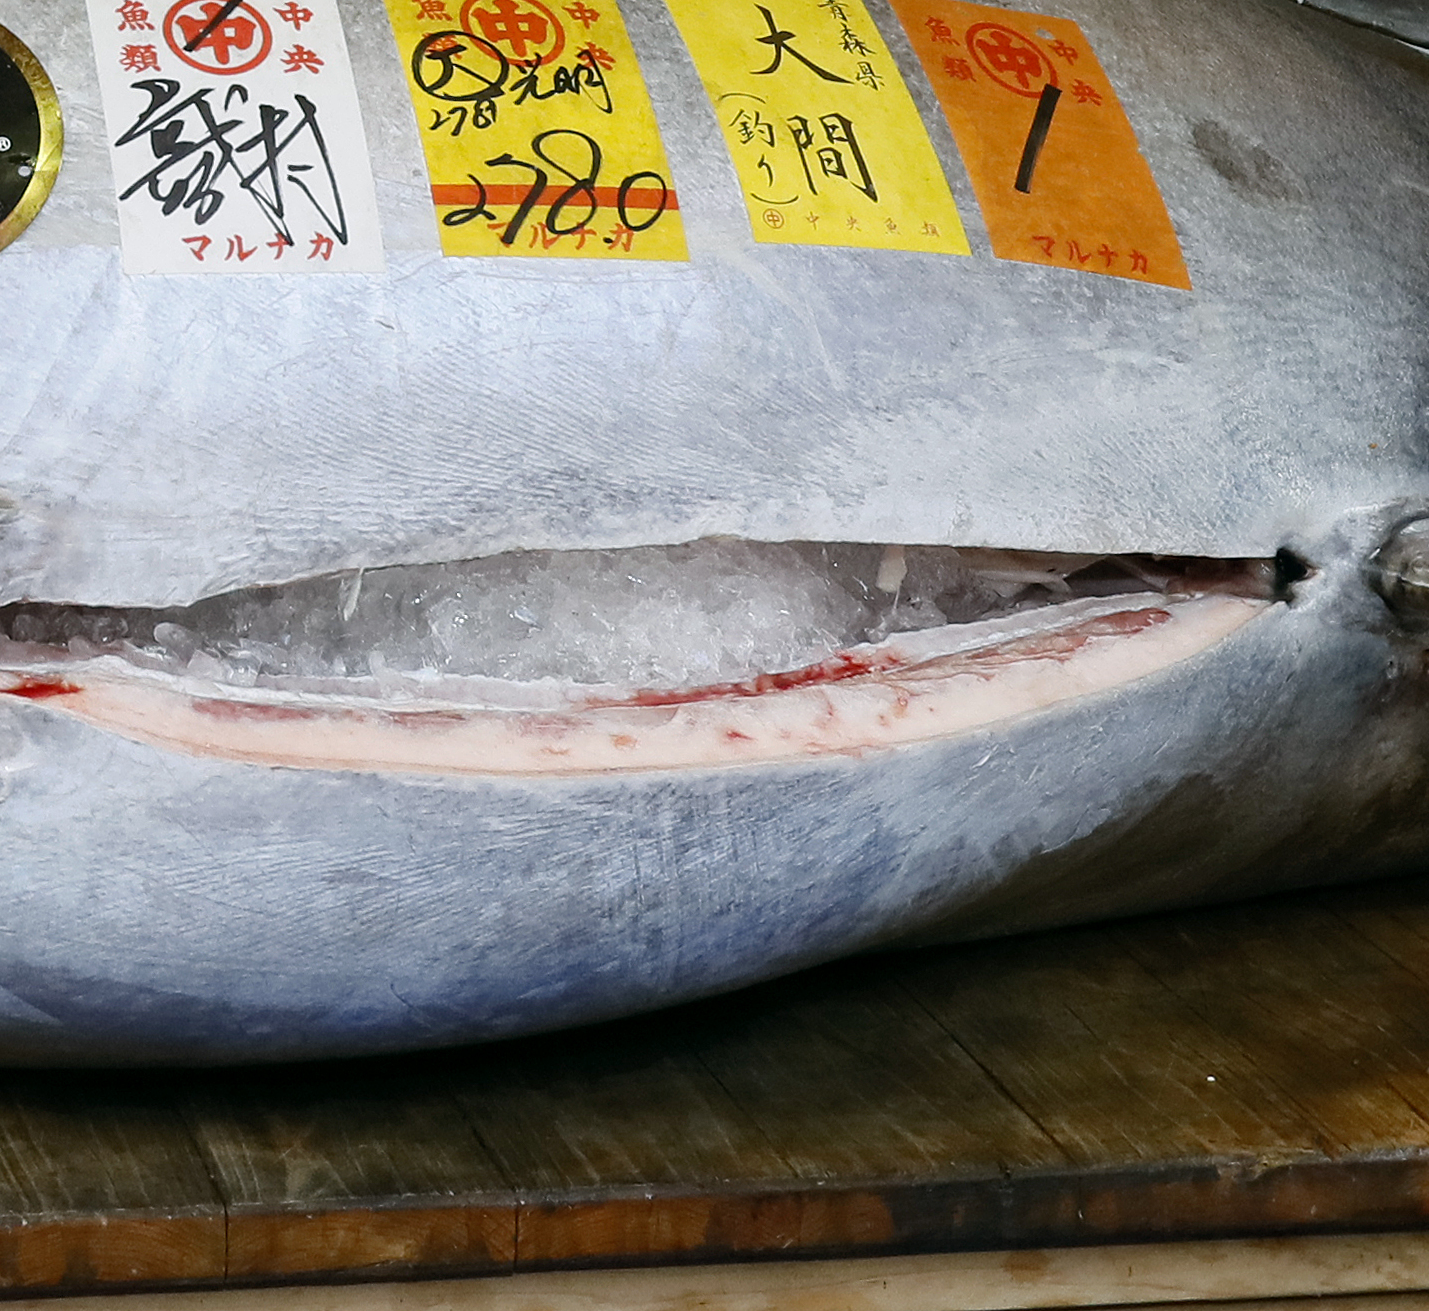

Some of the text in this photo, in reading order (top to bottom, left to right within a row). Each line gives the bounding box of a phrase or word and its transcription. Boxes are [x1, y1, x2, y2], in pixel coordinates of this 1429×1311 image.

[115, 0, 162, 73] 魚類
[273, 1, 325, 74] 中央
[750, 3, 878, 204] 大間
[181, 232, 334, 262] マルナカ
[1032, 235, 1149, 275] マルナカ
